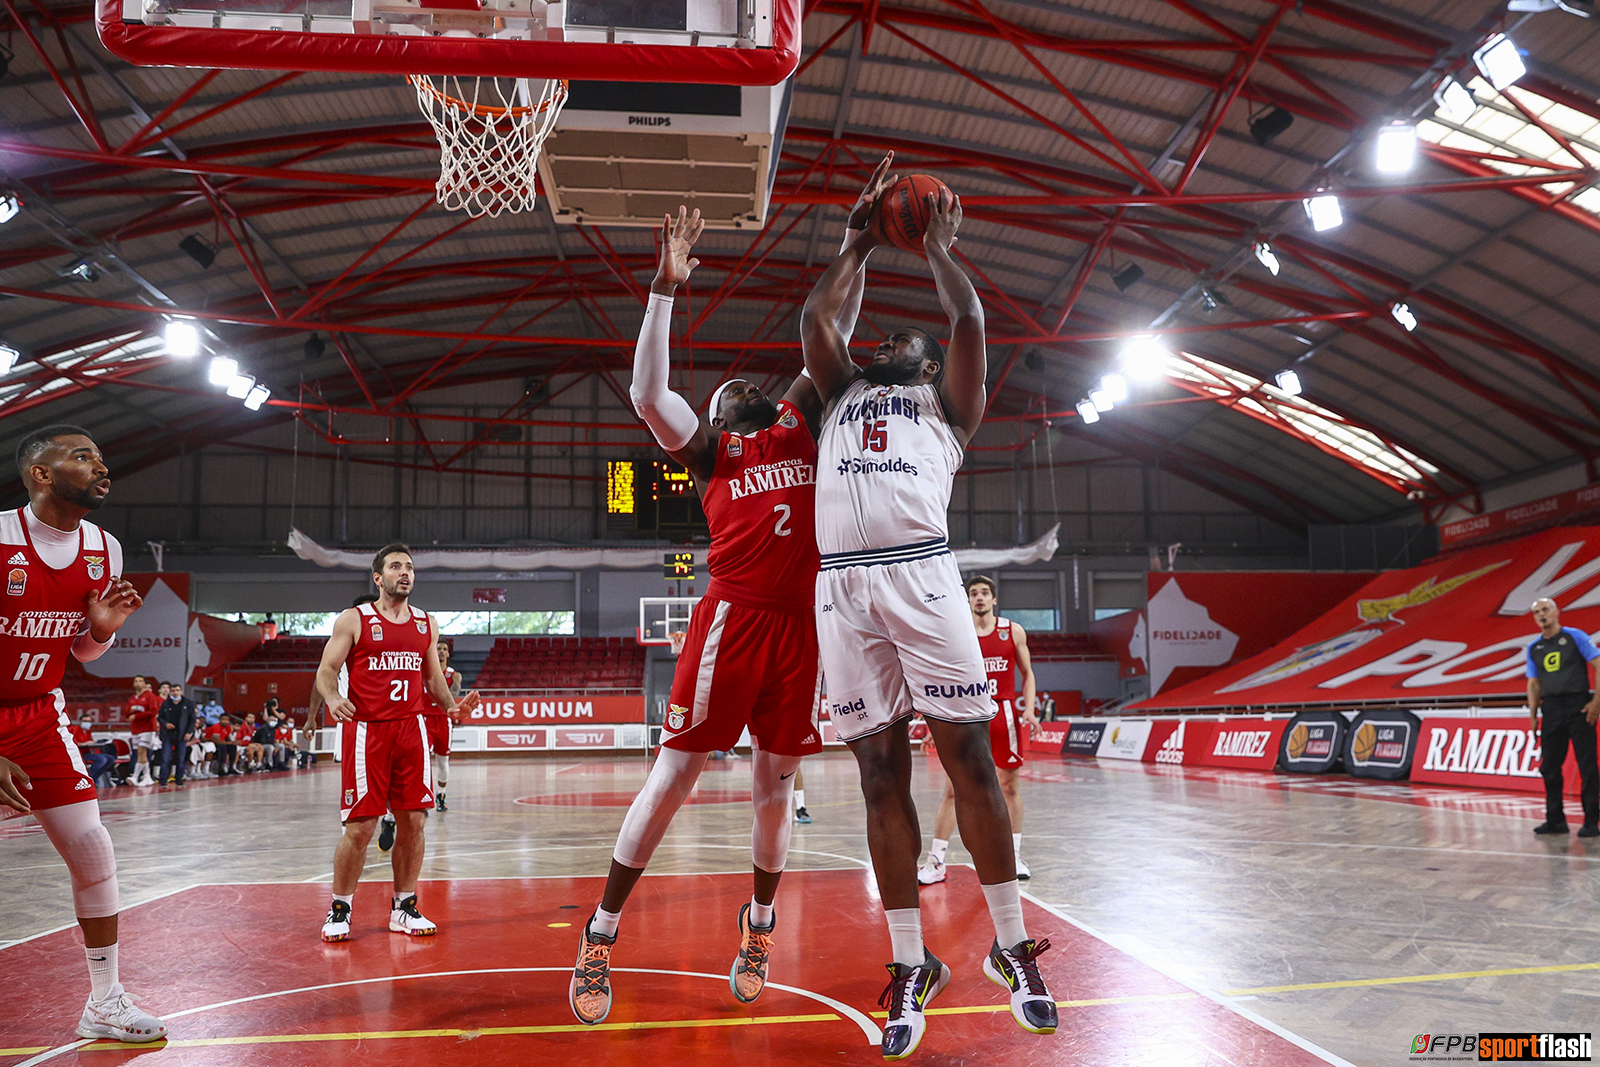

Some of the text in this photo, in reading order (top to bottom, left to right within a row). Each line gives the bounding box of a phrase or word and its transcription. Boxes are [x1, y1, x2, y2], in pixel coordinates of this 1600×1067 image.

[628, 115, 671, 126] PHILIPS
[898, 186, 920, 240] Wilson
[862, 420, 887, 453] 15
[743, 458, 803, 475] conservas
[852, 457, 918, 476] Simoldes
[728, 464, 816, 500] RAMIREZ
[773, 503, 792, 537] 2
[19, 610, 83, 619] conservas
[1153, 629, 1222, 641] FIDELIDADE
[12, 652, 51, 681] 10
[389, 679, 409, 702] 21
[523, 701, 594, 718] UNUM
[1309, 728, 1324, 739] LIGA
[1377, 728, 1395, 740] LIGA
[1212, 730, 1272, 758] RAMIREZ
[1422, 727, 1543, 778] RAMIRE
[1154, 748, 1185, 765] adidas
